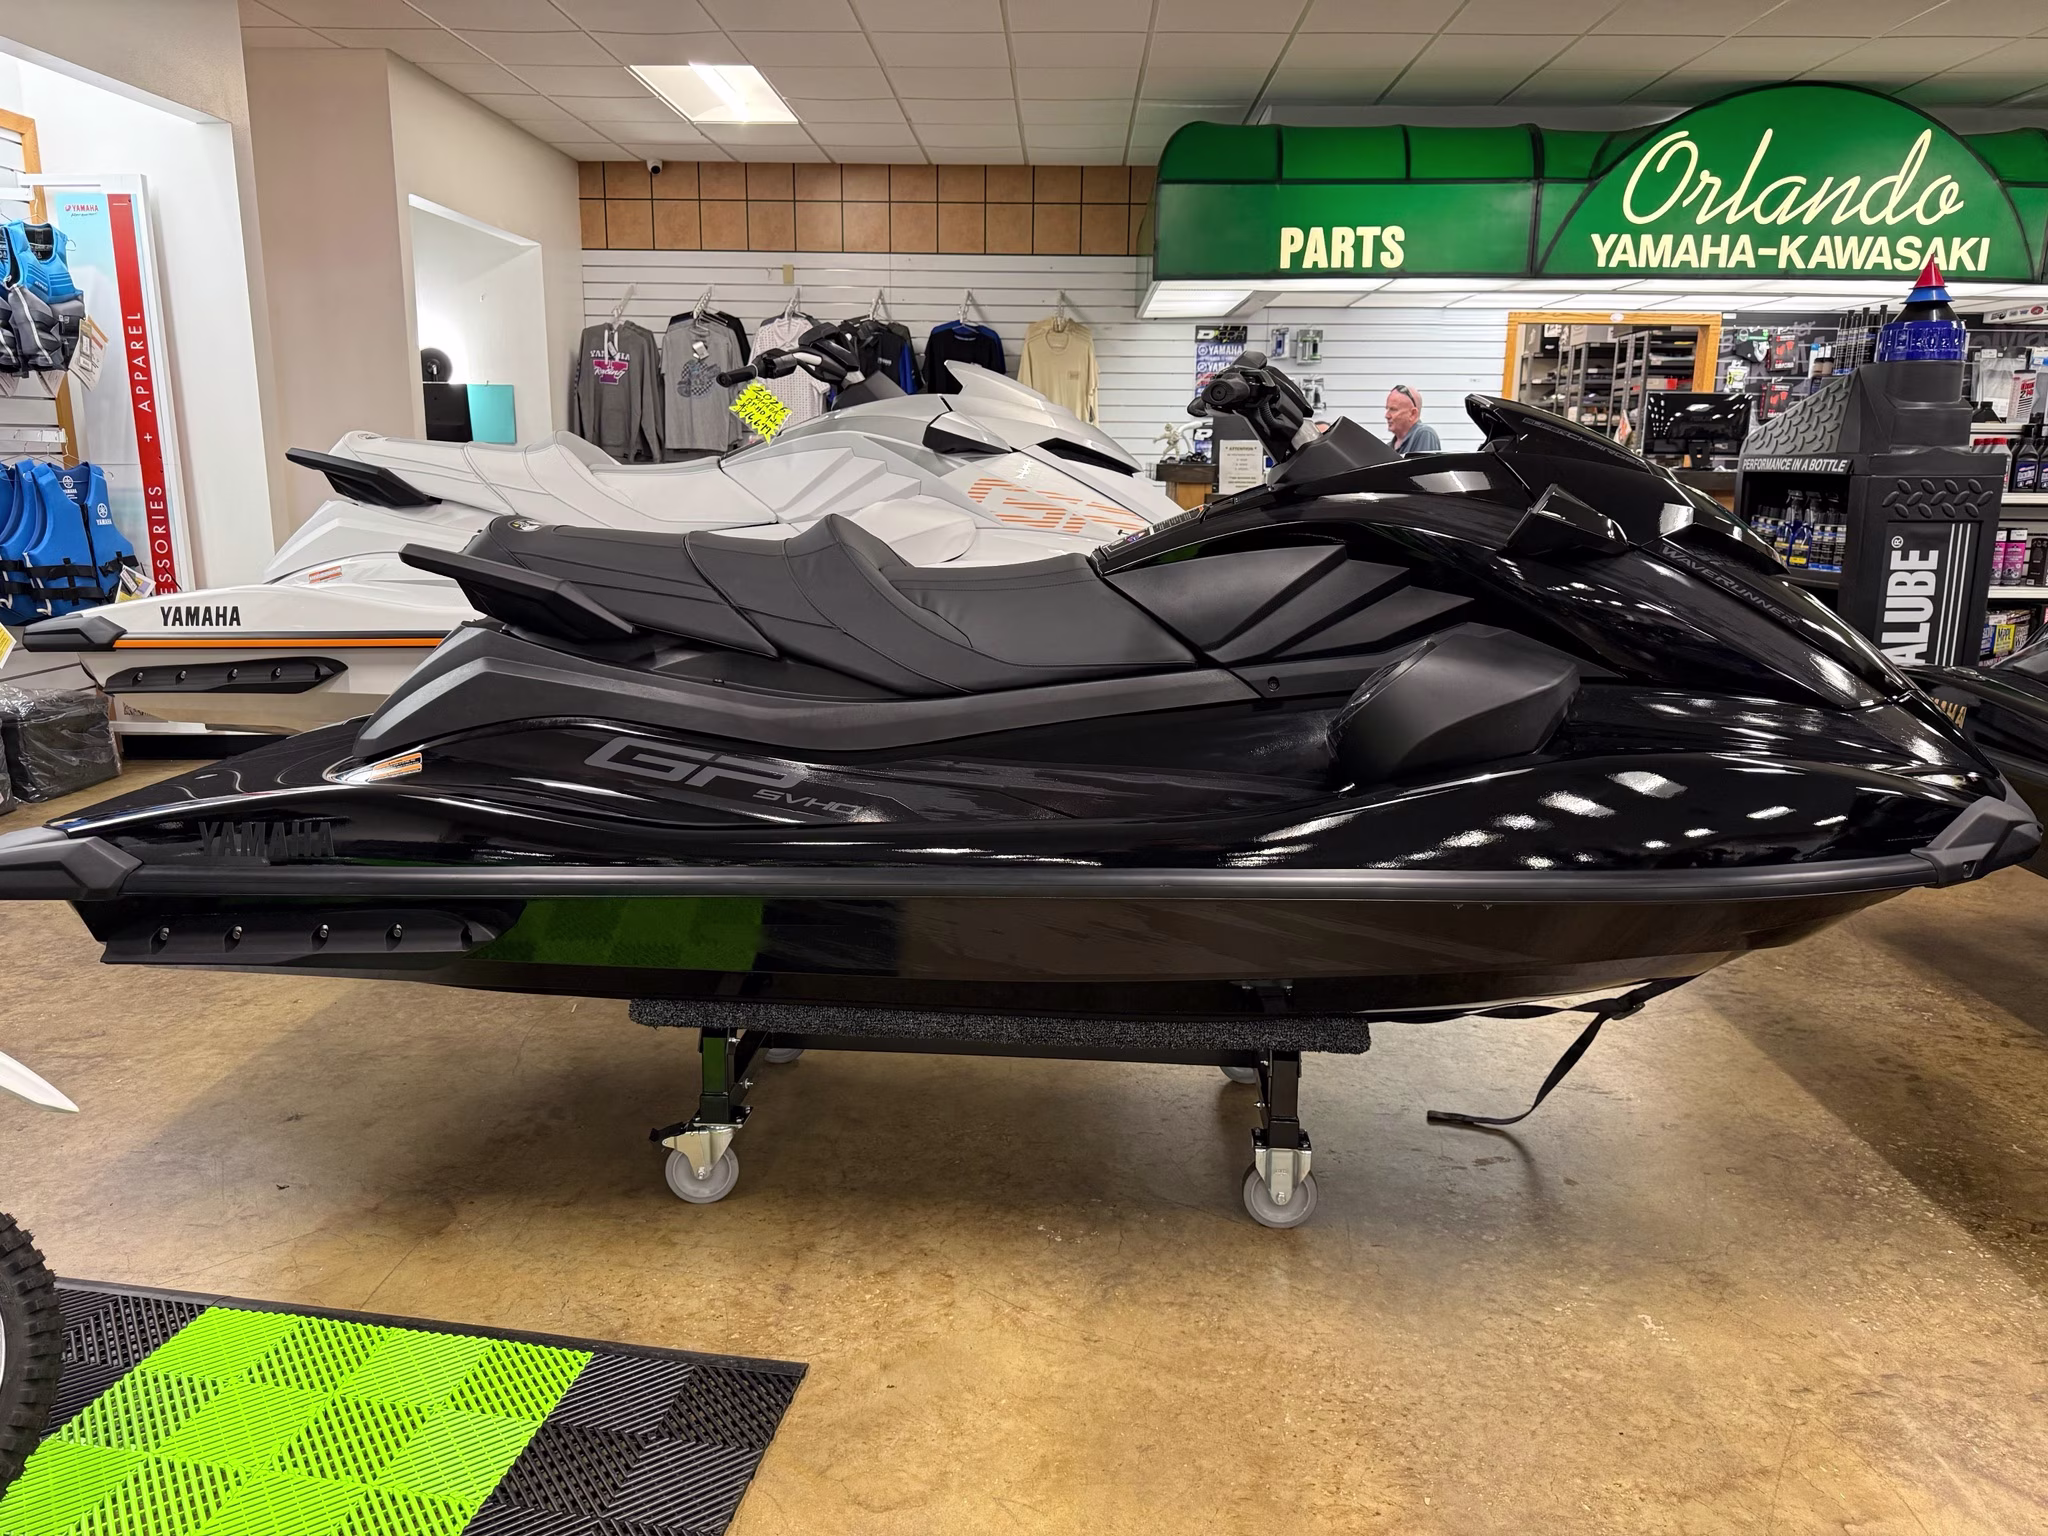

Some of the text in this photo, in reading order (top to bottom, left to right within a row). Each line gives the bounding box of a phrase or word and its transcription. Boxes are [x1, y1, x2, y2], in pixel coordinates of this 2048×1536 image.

[1621, 128, 1965, 226] Orlando
[72, 204, 98, 212] YAMAHA
[1279, 225, 1406, 269] PARTS
[1590, 233, 1990, 272] YAMAHA-KAWASAKI
[127, 312, 153, 413] APPAREL
[1209, 345, 1243, 356] YAMAHA
[752, 386, 789, 413] 2026
[1742, 458, 1793, 471] PERFORMANCE
[1791, 458, 1803, 471] IN
[1809, 458, 1848, 473] BOTTLE
[1662, 543, 1797, 624] WAVERUNNER
[160, 605, 242, 627] YAMAHA
[583, 736, 808, 789] GP
[198, 821, 336, 858] YAMAHA
